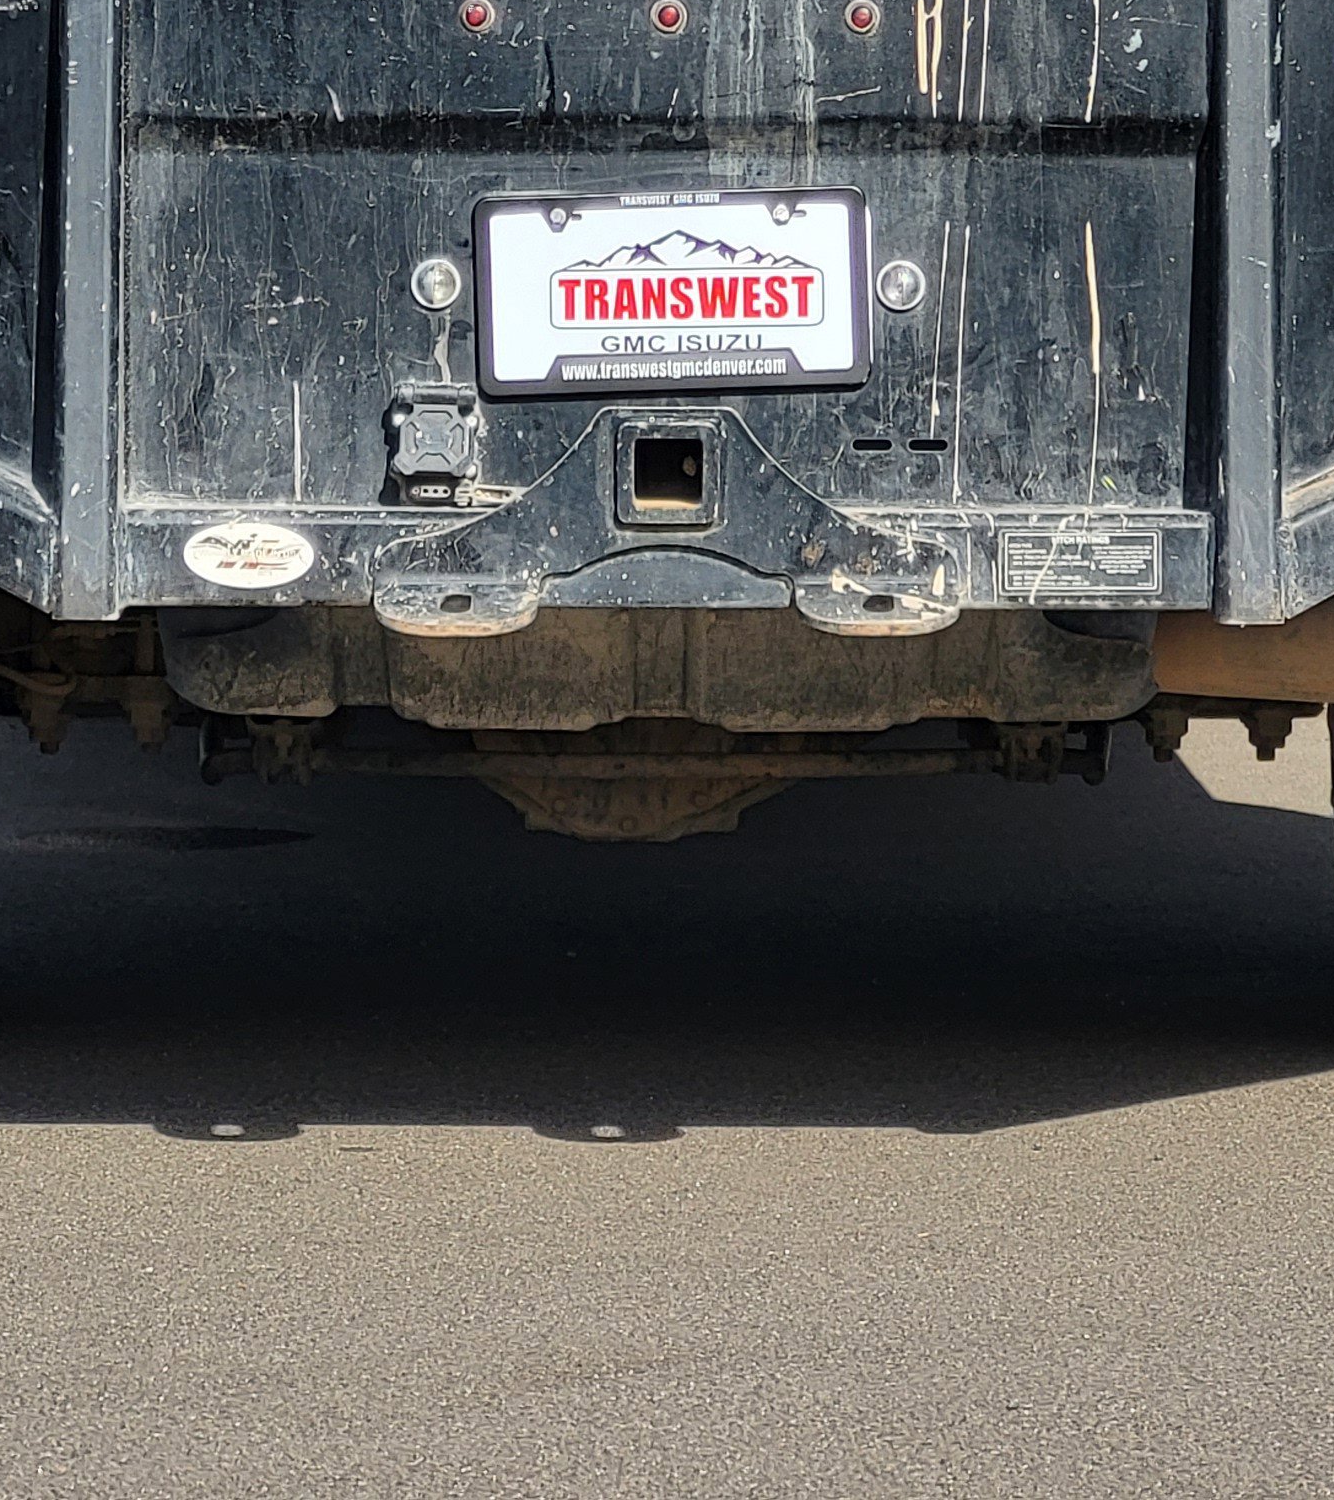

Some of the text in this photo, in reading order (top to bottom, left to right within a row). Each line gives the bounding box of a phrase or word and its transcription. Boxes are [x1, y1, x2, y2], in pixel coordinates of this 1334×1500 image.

[558, 275, 814, 321] TRANSWEST
[600, 333, 763, 353] GMC ISUZU
[561, 356, 787, 381] www.transwestgmcdenver.com
